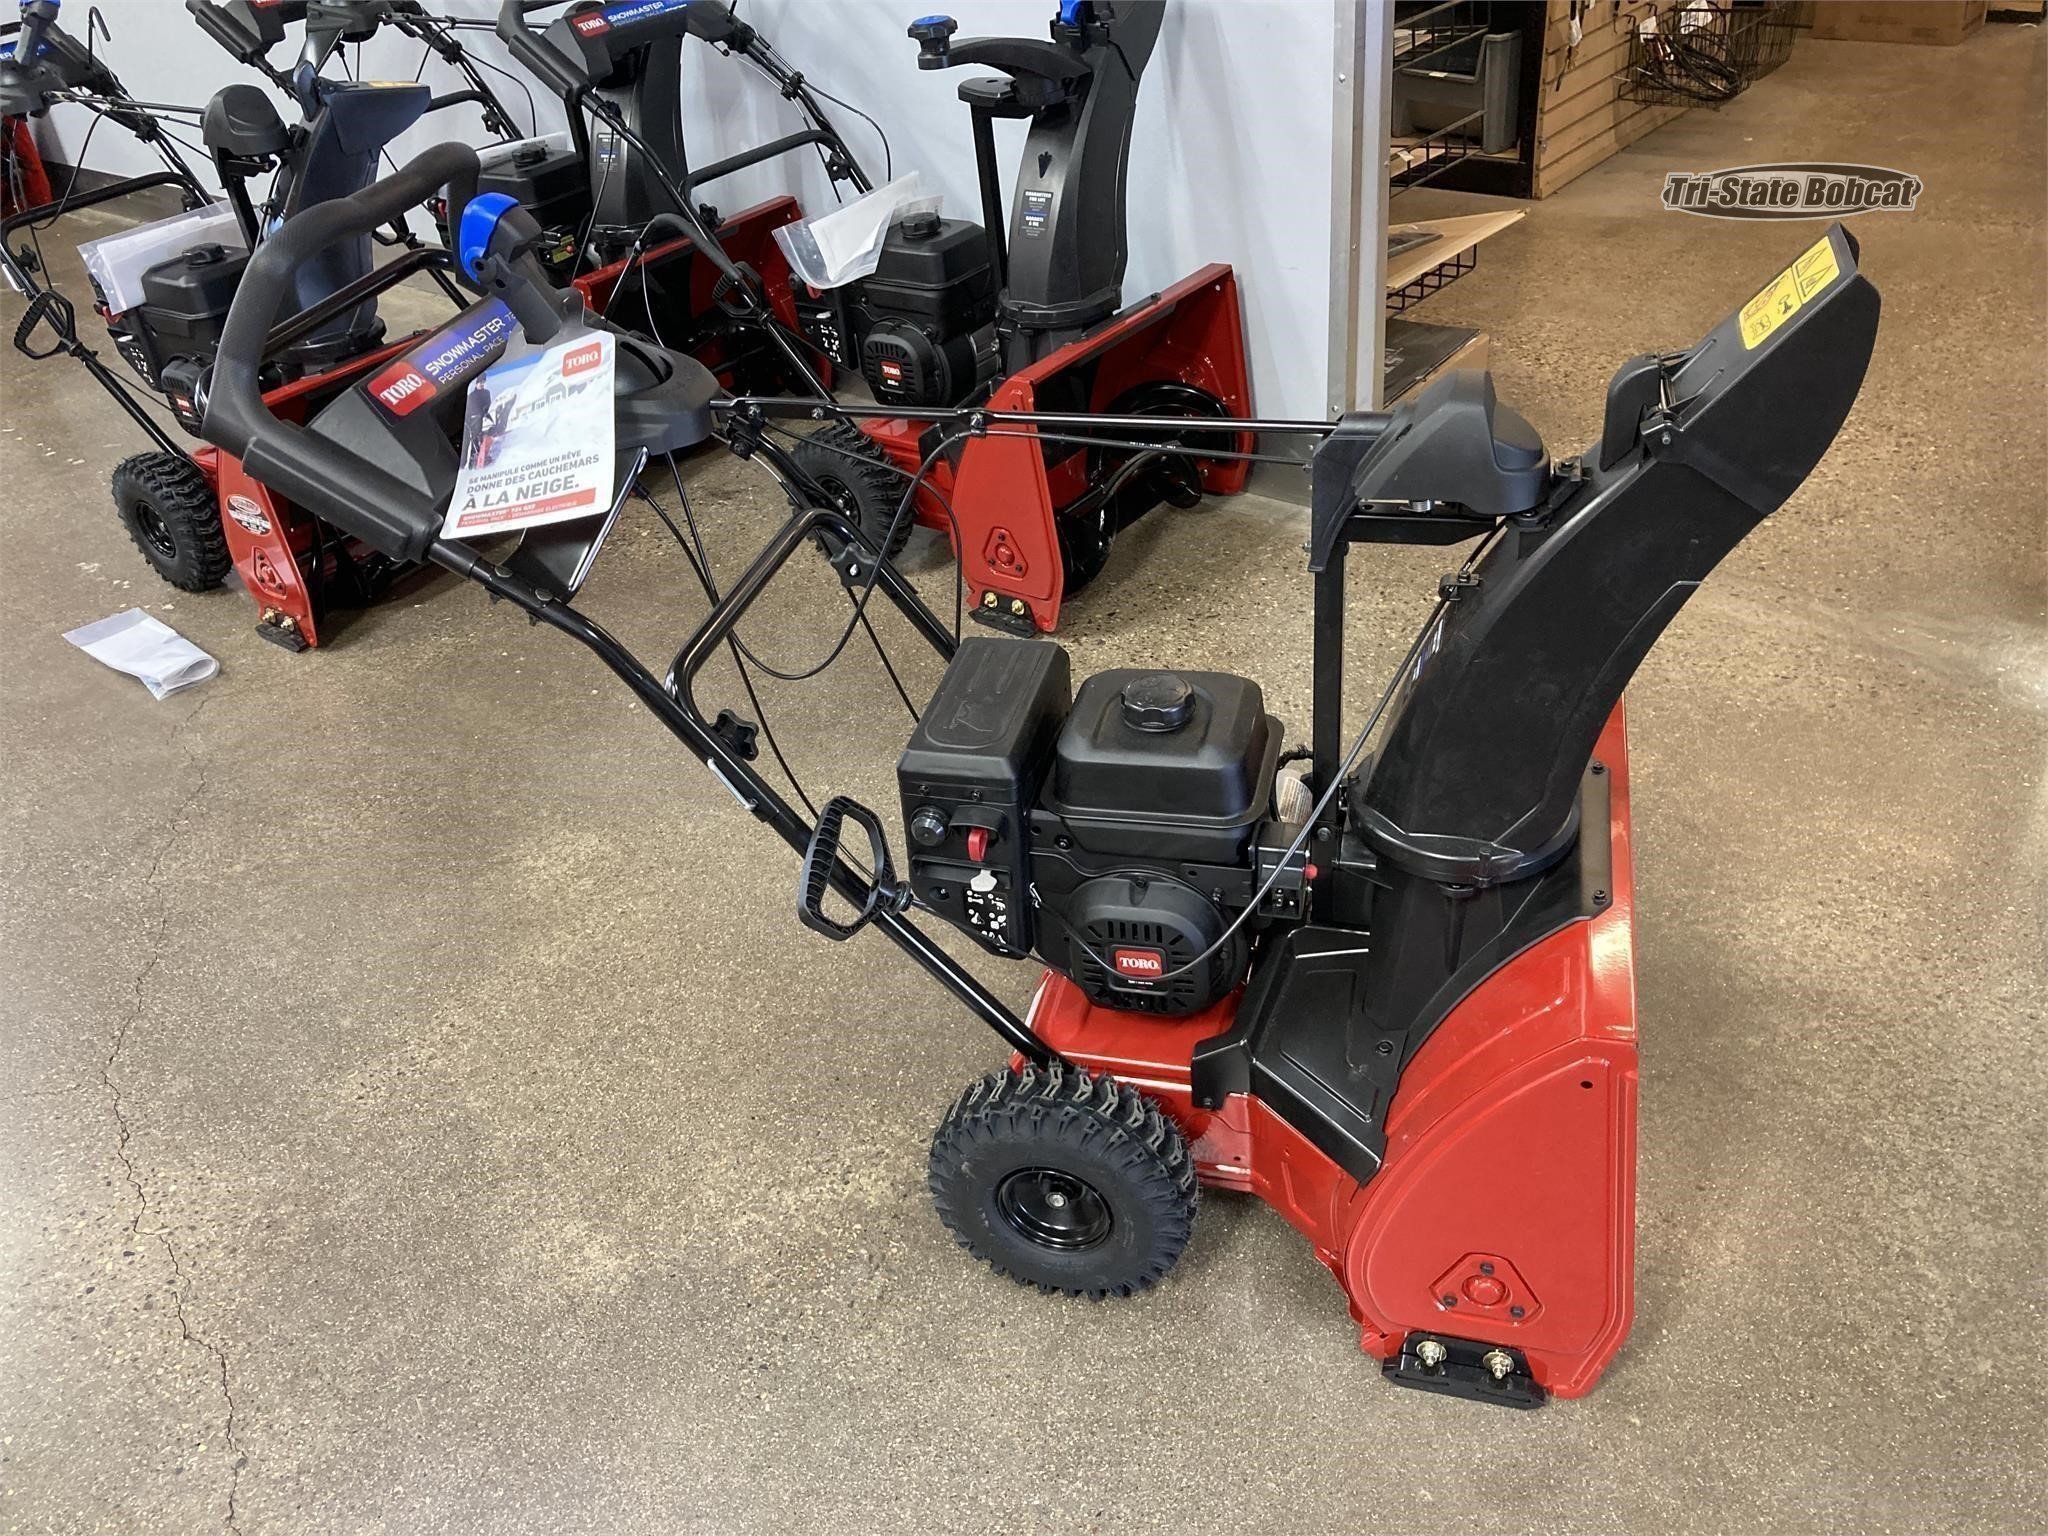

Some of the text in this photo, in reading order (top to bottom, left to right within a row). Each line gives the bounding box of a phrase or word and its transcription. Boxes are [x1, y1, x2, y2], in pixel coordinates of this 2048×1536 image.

[578, 17, 606, 31] TORO
[608, 1, 665, 22] SNOWMASTER
[425, 317, 506, 376] SNOWMASTER
[438, 335, 506, 385] PERSONAL PACE
[566, 350, 599, 369] TORO
[380, 373, 424, 405] TORO
[466, 454, 600, 494] DONNE DES CAUCHEMARS
[480, 467, 519, 482] MANIPULE
[520, 460, 548, 472] COMME
[549, 457, 561, 465] UN
[561, 449, 582, 462] RÊVE
[461, 474, 580, 511] À LA NEIGE.
[1119, 957, 1159, 970] TORO
